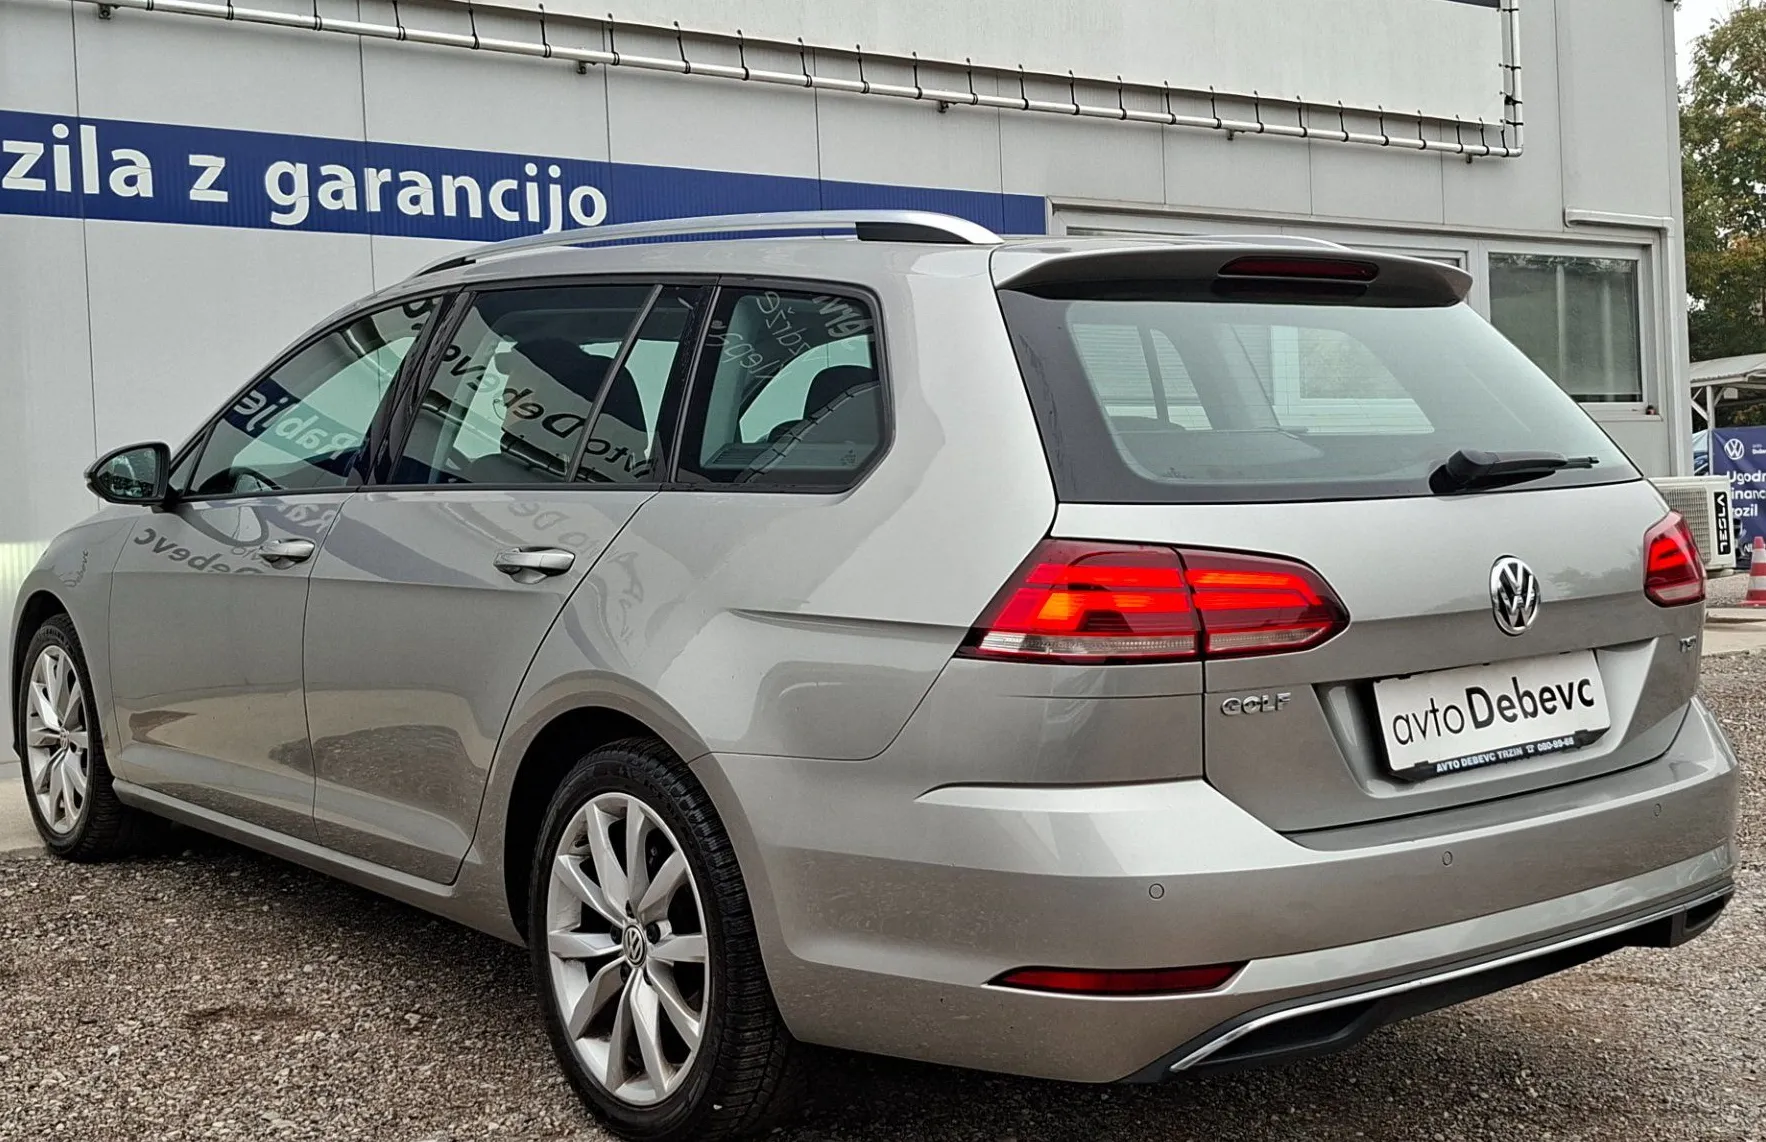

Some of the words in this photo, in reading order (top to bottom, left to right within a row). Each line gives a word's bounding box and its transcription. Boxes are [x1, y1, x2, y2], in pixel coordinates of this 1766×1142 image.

[2, 123, 154, 199] zila
[187, 153, 229, 203] z
[264, 160, 608, 234] garancijo
[1716, 493, 1729, 553] TESLA
[1732, 503, 1759, 518] ozil
[1221, 692, 1292, 716] GOLF
[1436, 760, 1461, 773] AVTO
[1461, 752, 1496, 767] DEBEVC
[1496, 746, 1523, 760] TRZIN
